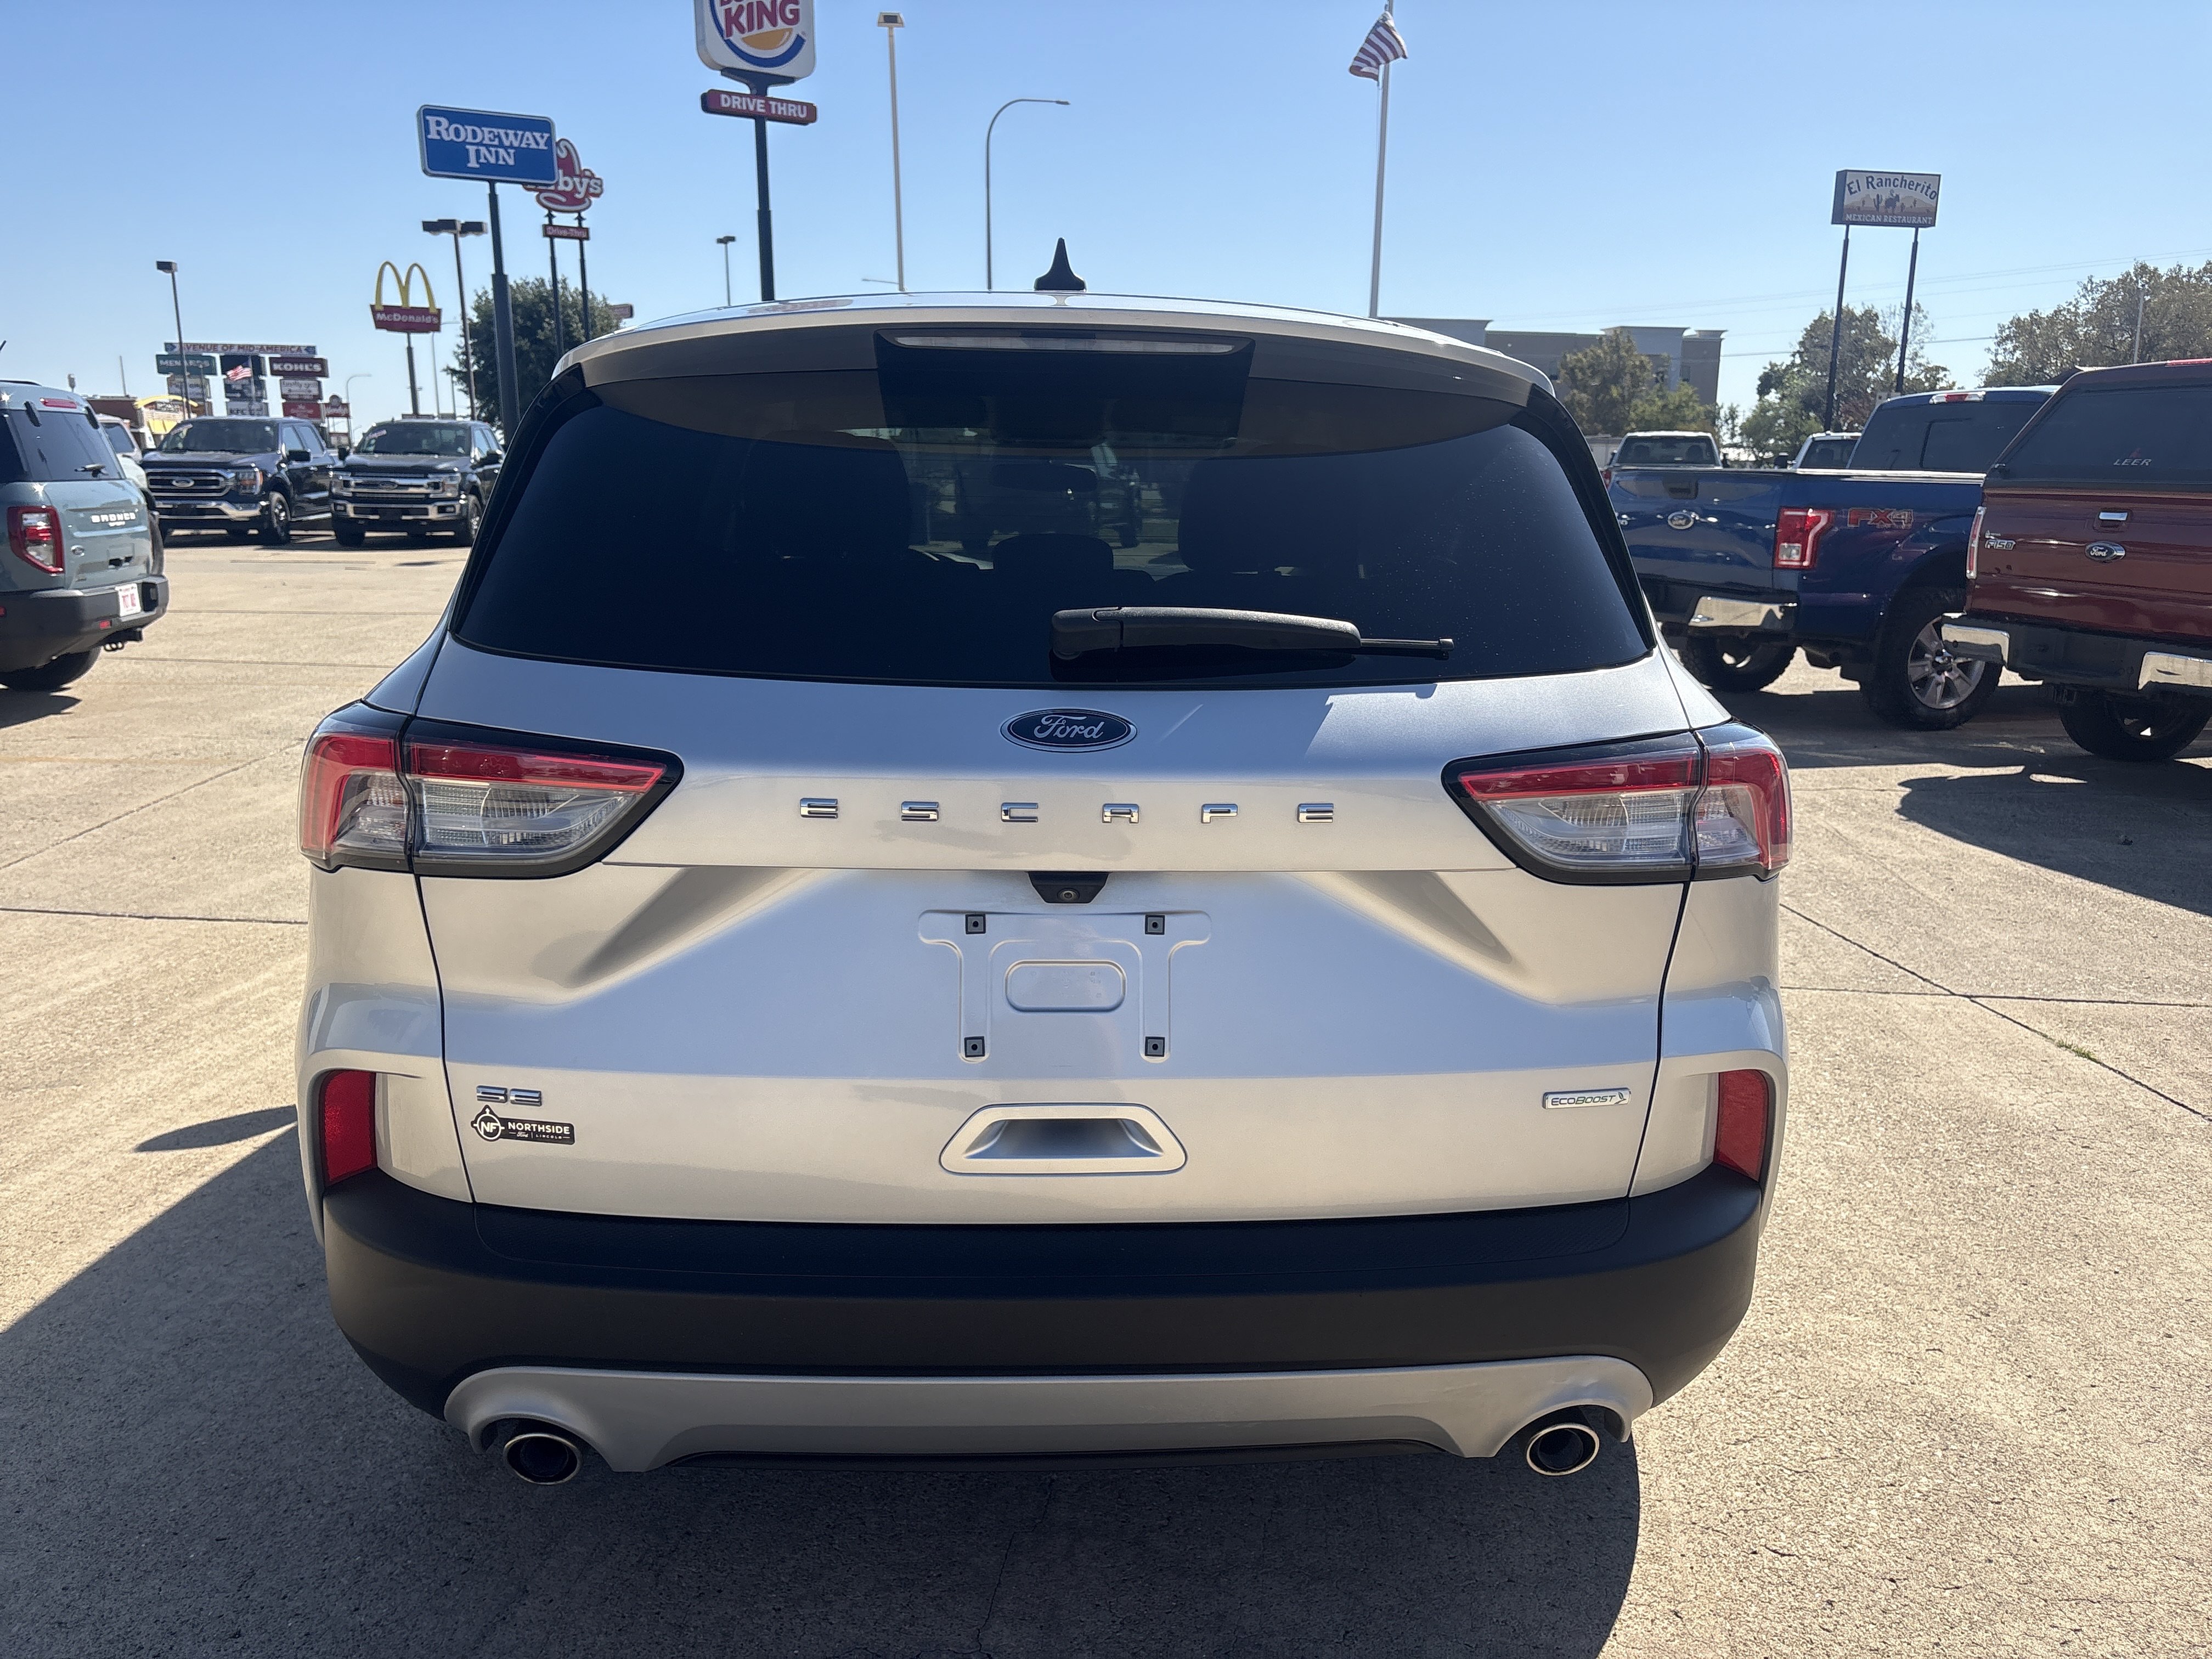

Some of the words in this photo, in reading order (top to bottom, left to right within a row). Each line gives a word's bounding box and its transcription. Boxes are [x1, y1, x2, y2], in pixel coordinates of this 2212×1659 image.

[725, 0, 800, 38] KING
[720, 94, 766, 112] DRIVE
[769, 101, 807, 118] THRU
[426, 116, 549, 150] RODEWAY
[466, 145, 516, 168] INN
[1847, 179, 1861, 195] El
[1866, 175, 1937, 200] Rancherito
[1846, 214, 1882, 222] MEXICAN
[1883, 215, 1933, 224] RESTAURANT
[376, 312, 439, 324] McDonald's
[160, 359, 210, 368] MENRDS
[273, 362, 322, 372] KOHL'S
[91, 512, 136, 523] BRONCO
[1847, 507, 1914, 529] FX4
[2090, 546, 2108, 557] Ford
[1034, 714, 1105, 739] Ford
[800, 797, 1334, 823] ESCAPE
[476, 1085, 542, 1107] SE
[481, 1121, 496, 1132] NF
[508, 1122, 571, 1135] NORTHSIDE
